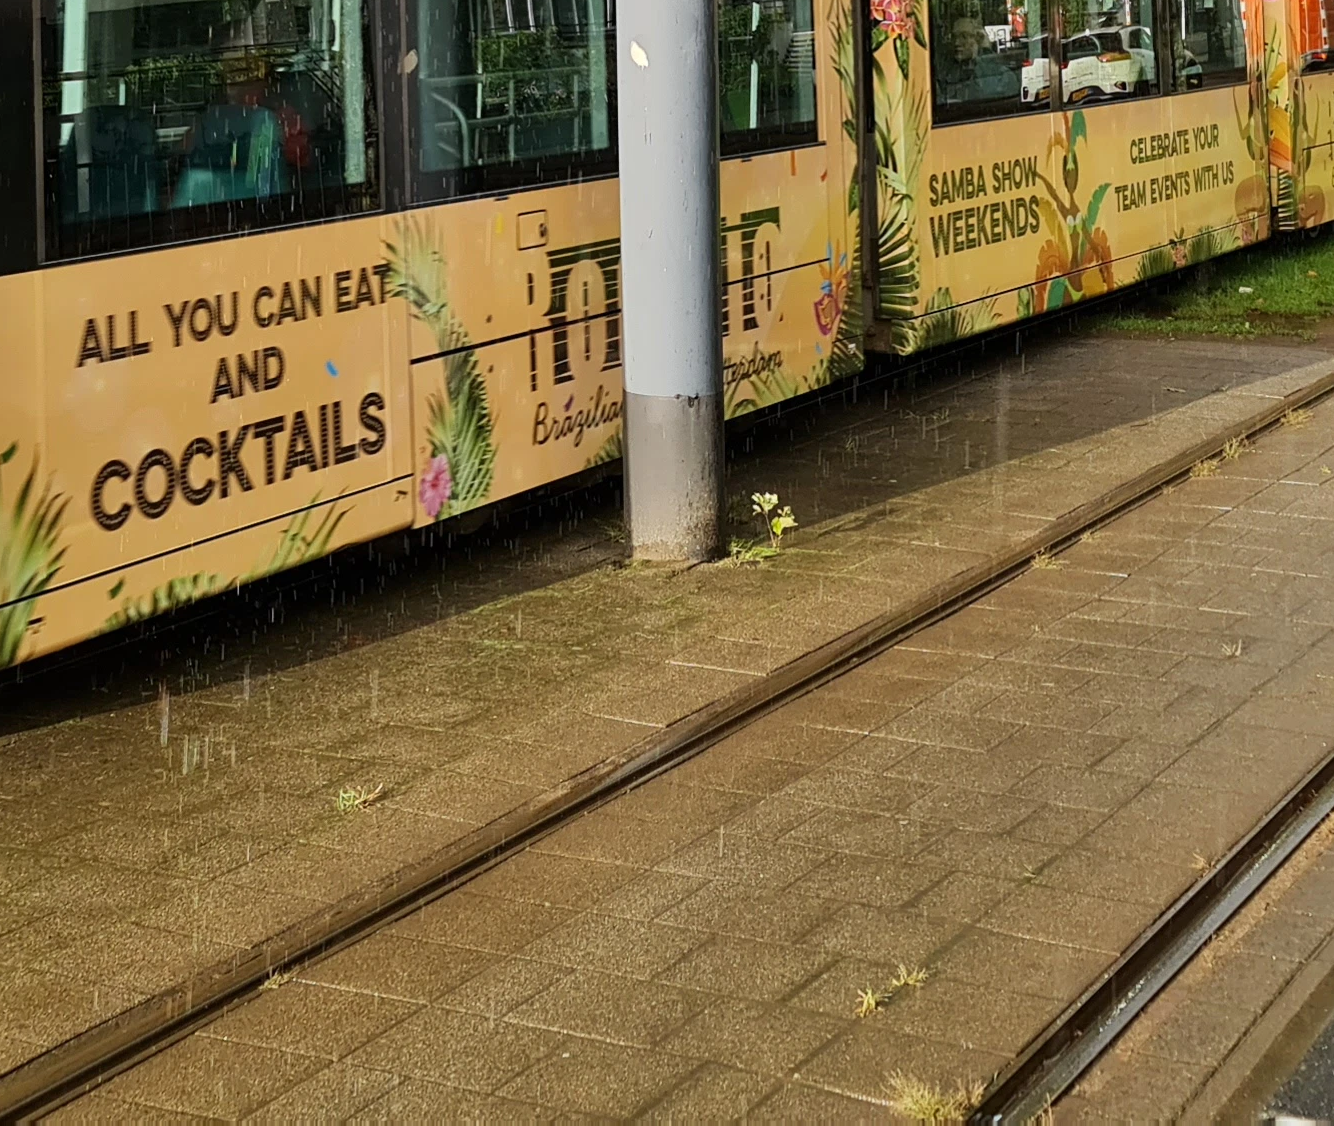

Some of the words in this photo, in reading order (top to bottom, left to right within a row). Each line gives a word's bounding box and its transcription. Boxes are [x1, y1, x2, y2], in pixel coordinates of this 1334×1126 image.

[1130, 129, 1189, 165] CELEBRATE
[1192, 123, 1219, 153] YOUR
[929, 165, 988, 207] SAMBA
[992, 155, 1037, 194] SHOW
[1115, 180, 1146, 213] TEAM
[1150, 170, 1191, 205] EVENTS
[1193, 163, 1219, 193] WITH
[1222, 160, 1234, 186] US
[929, 194, 1040, 258] WEEKENDS
[75, 311, 152, 368] ALL
[162, 290, 240, 347] YOU
[252, 276, 323, 329] CAN
[334, 262, 392, 313] EAT
[209, 346, 286, 404] AND
[532, 384, 623, 447] Brazilia
[90, 392, 388, 532] COCKTAILS
